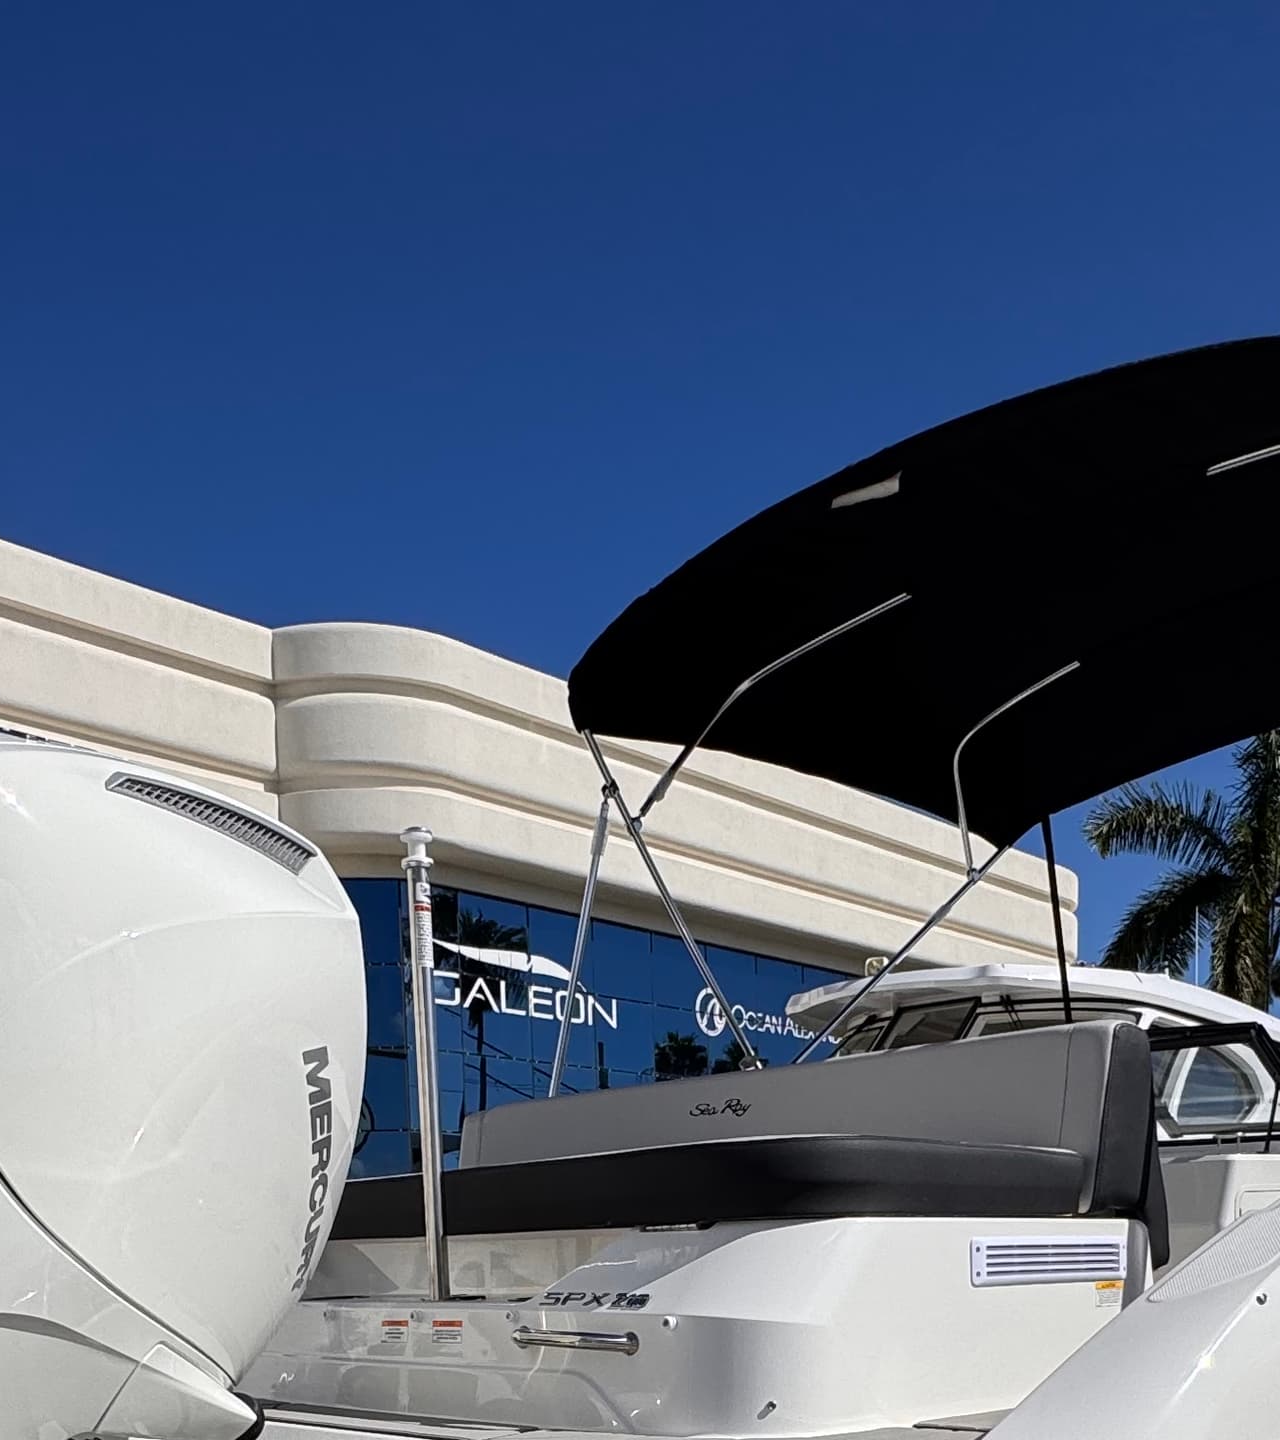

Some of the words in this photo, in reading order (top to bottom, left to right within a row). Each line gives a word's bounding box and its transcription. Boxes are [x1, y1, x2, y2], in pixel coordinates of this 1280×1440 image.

[433, 969, 618, 1030] GALEON
[730, 1004, 782, 1036] OCEAN
[689, 1103, 720, 1117] Sea
[720, 1098, 752, 1117] Ray
[539, 1291, 611, 1307] SPX
